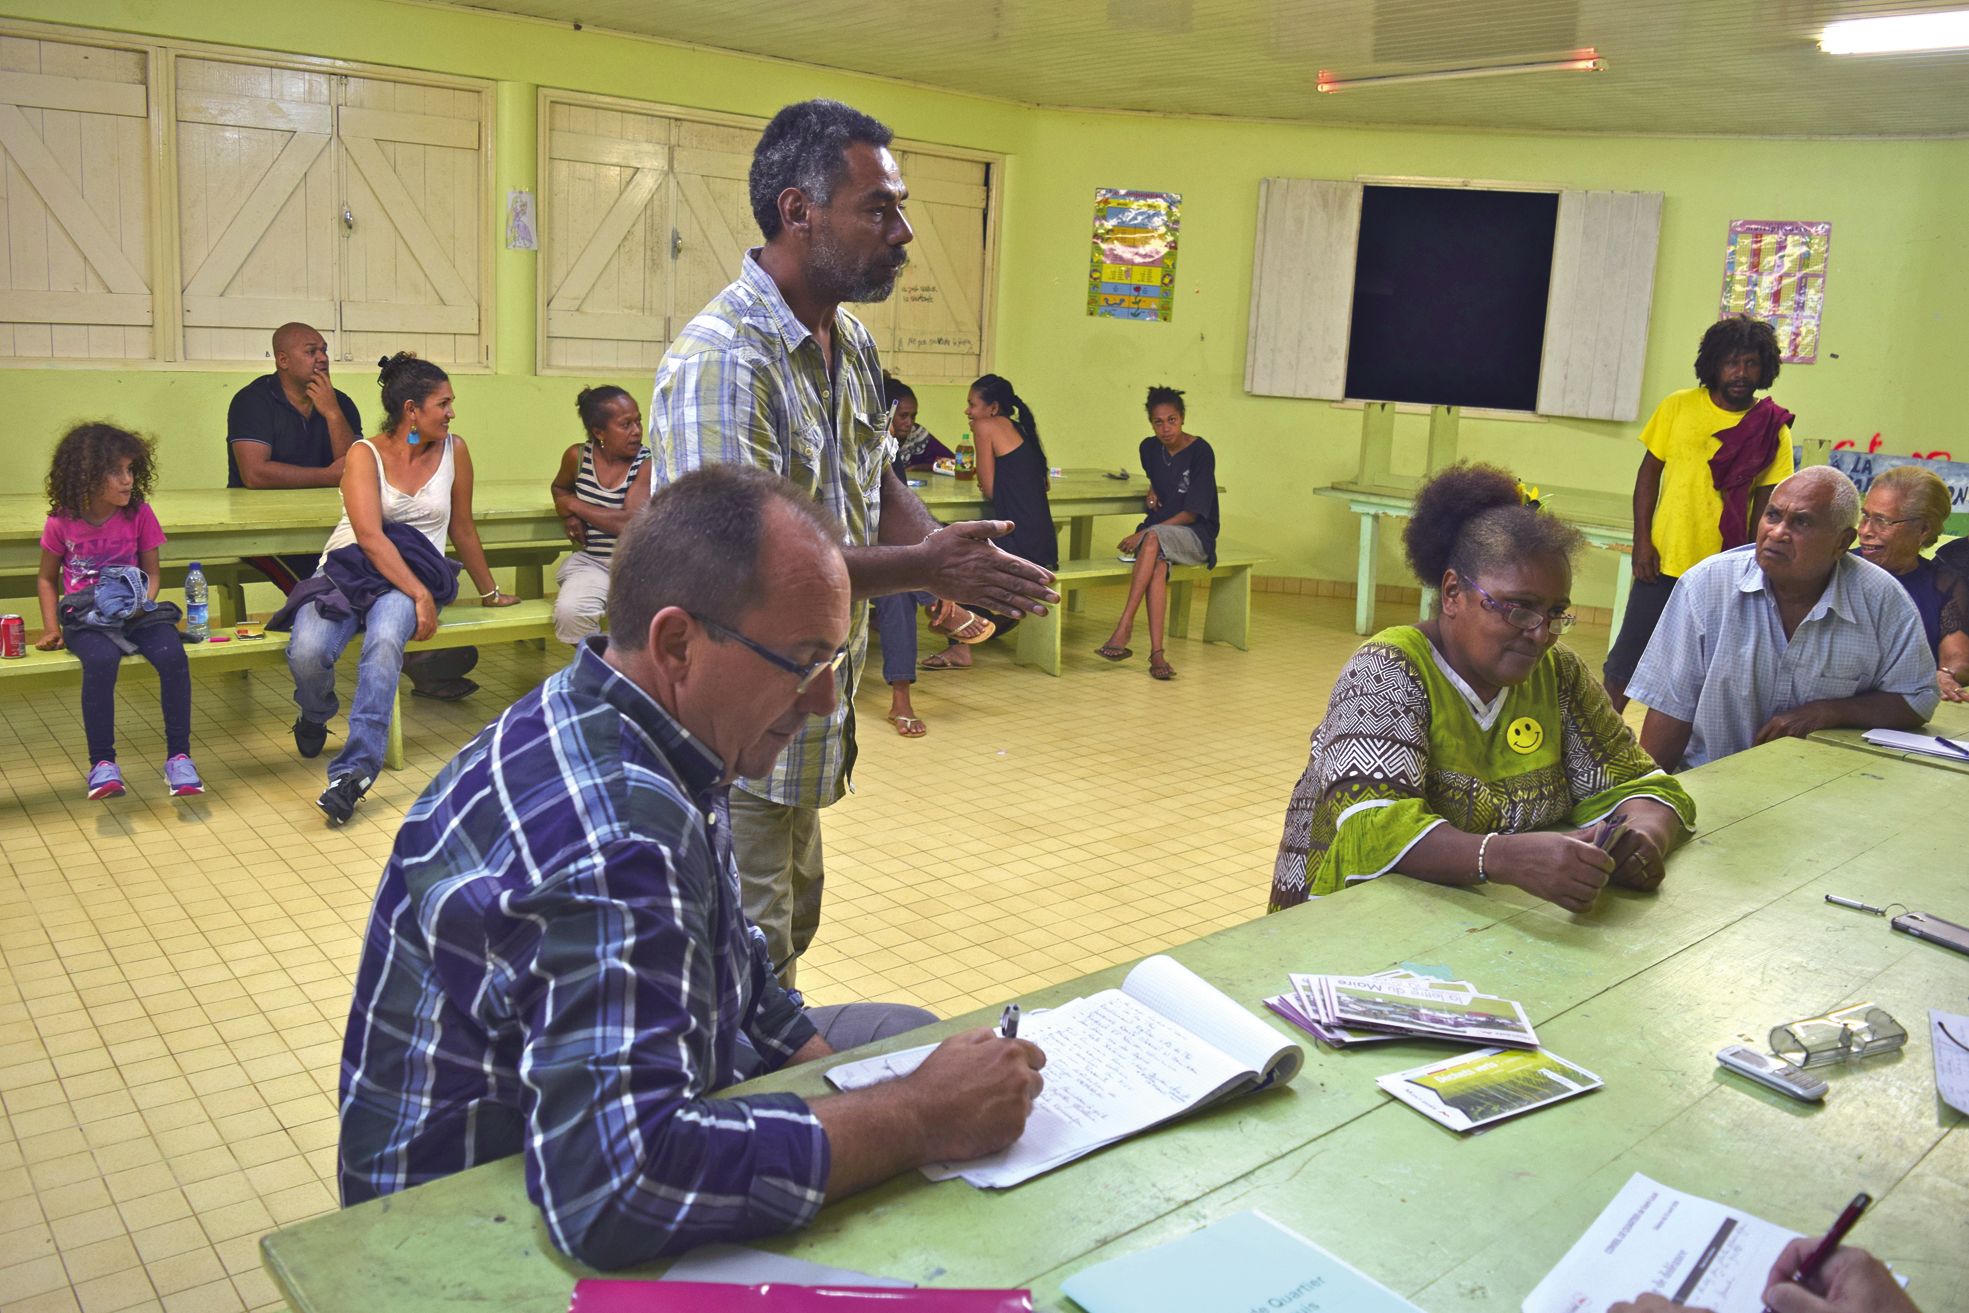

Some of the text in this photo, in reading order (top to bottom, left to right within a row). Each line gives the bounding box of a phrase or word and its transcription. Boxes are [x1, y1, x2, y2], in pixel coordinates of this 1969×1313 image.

[1850, 456, 1873, 475] LA
[1337, 978, 1382, 992] Maire
[1267, 1276, 1325, 1309] Quartier
